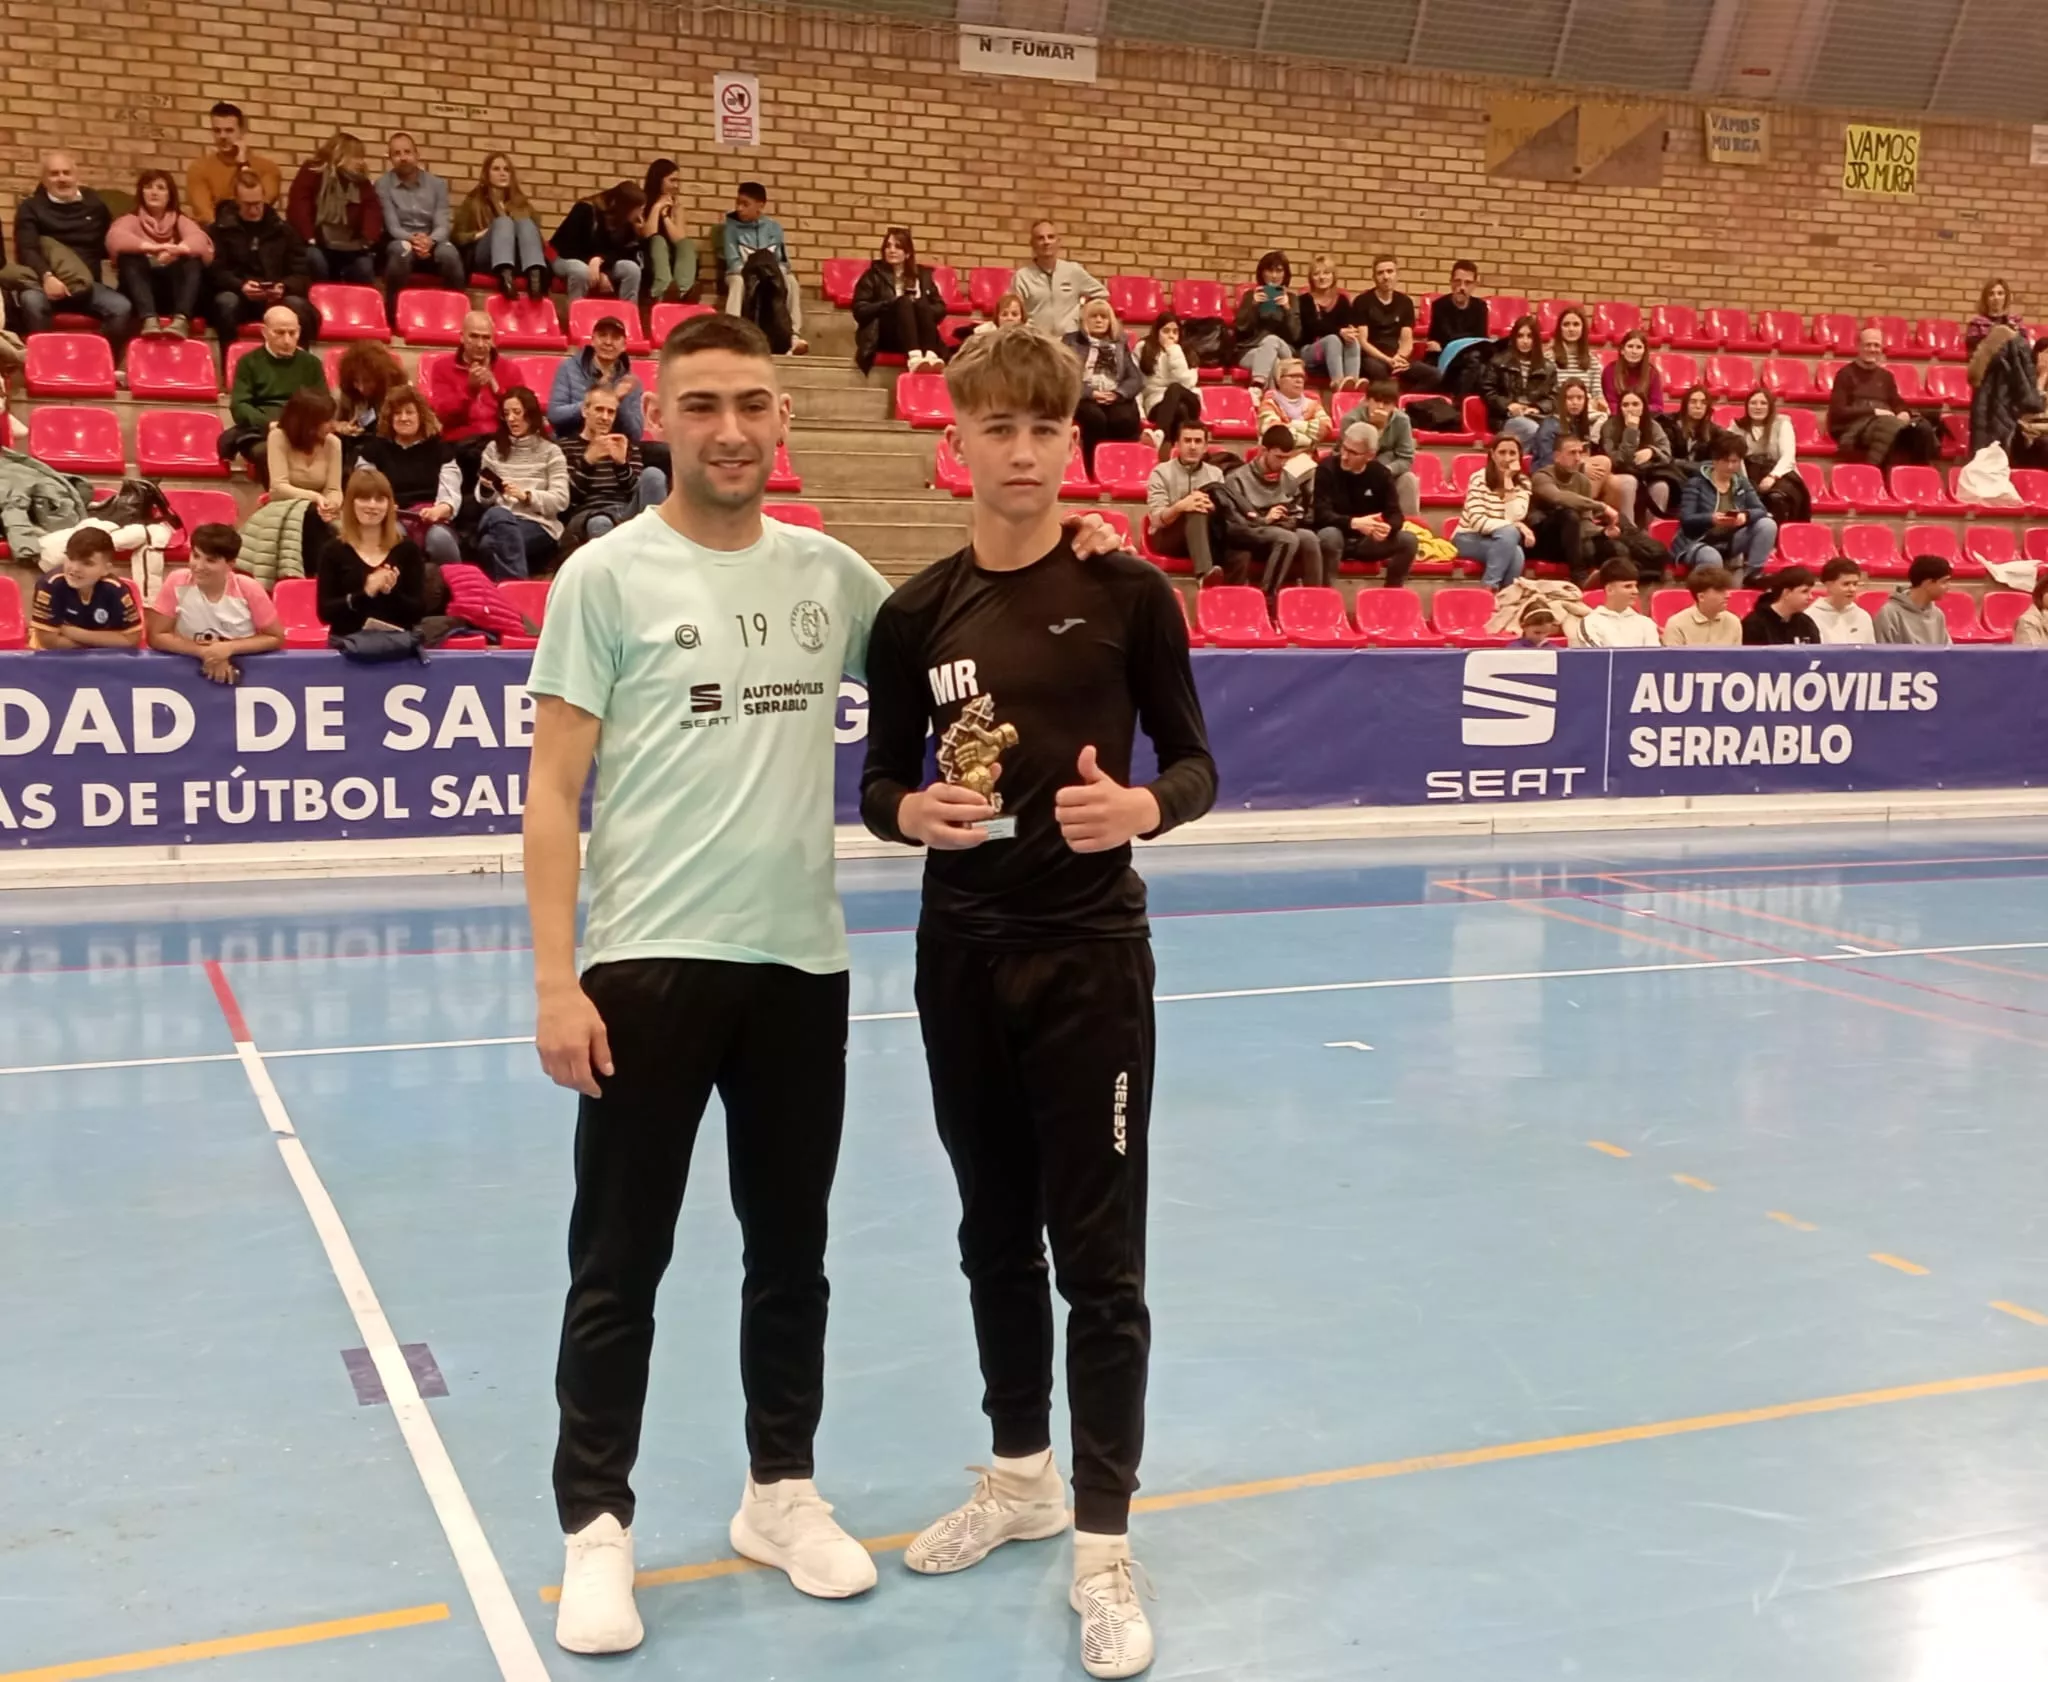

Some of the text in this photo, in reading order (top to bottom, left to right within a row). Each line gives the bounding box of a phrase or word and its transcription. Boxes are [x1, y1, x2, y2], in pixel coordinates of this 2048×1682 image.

[1012, 40, 1075, 60] FUMAR
[1711, 116, 1760, 133] VAMOS
[1711, 136, 1761, 153] MURGA
[1848, 130, 1917, 166] VAMOS
[1845, 161, 1914, 193] JR MURGA
[735, 612, 768, 648] 19
[742, 680, 824, 700] AUTOMÓVILES
[928, 658, 979, 707] MR
[1629, 660, 1939, 713] AUTOMÓVILES
[0, 687, 196, 755] DAD
[235, 686, 346, 752] DE
[679, 716, 731, 730] SEAT
[743, 698, 808, 715] SERRABLO
[1628, 724, 1852, 768] SERRABLO
[82, 782, 158, 827] DE
[183, 765, 410, 825] FÚTBOL
[1426, 767, 1586, 798] SEAT
[1113, 1071, 1128, 1156] ACERBIS
